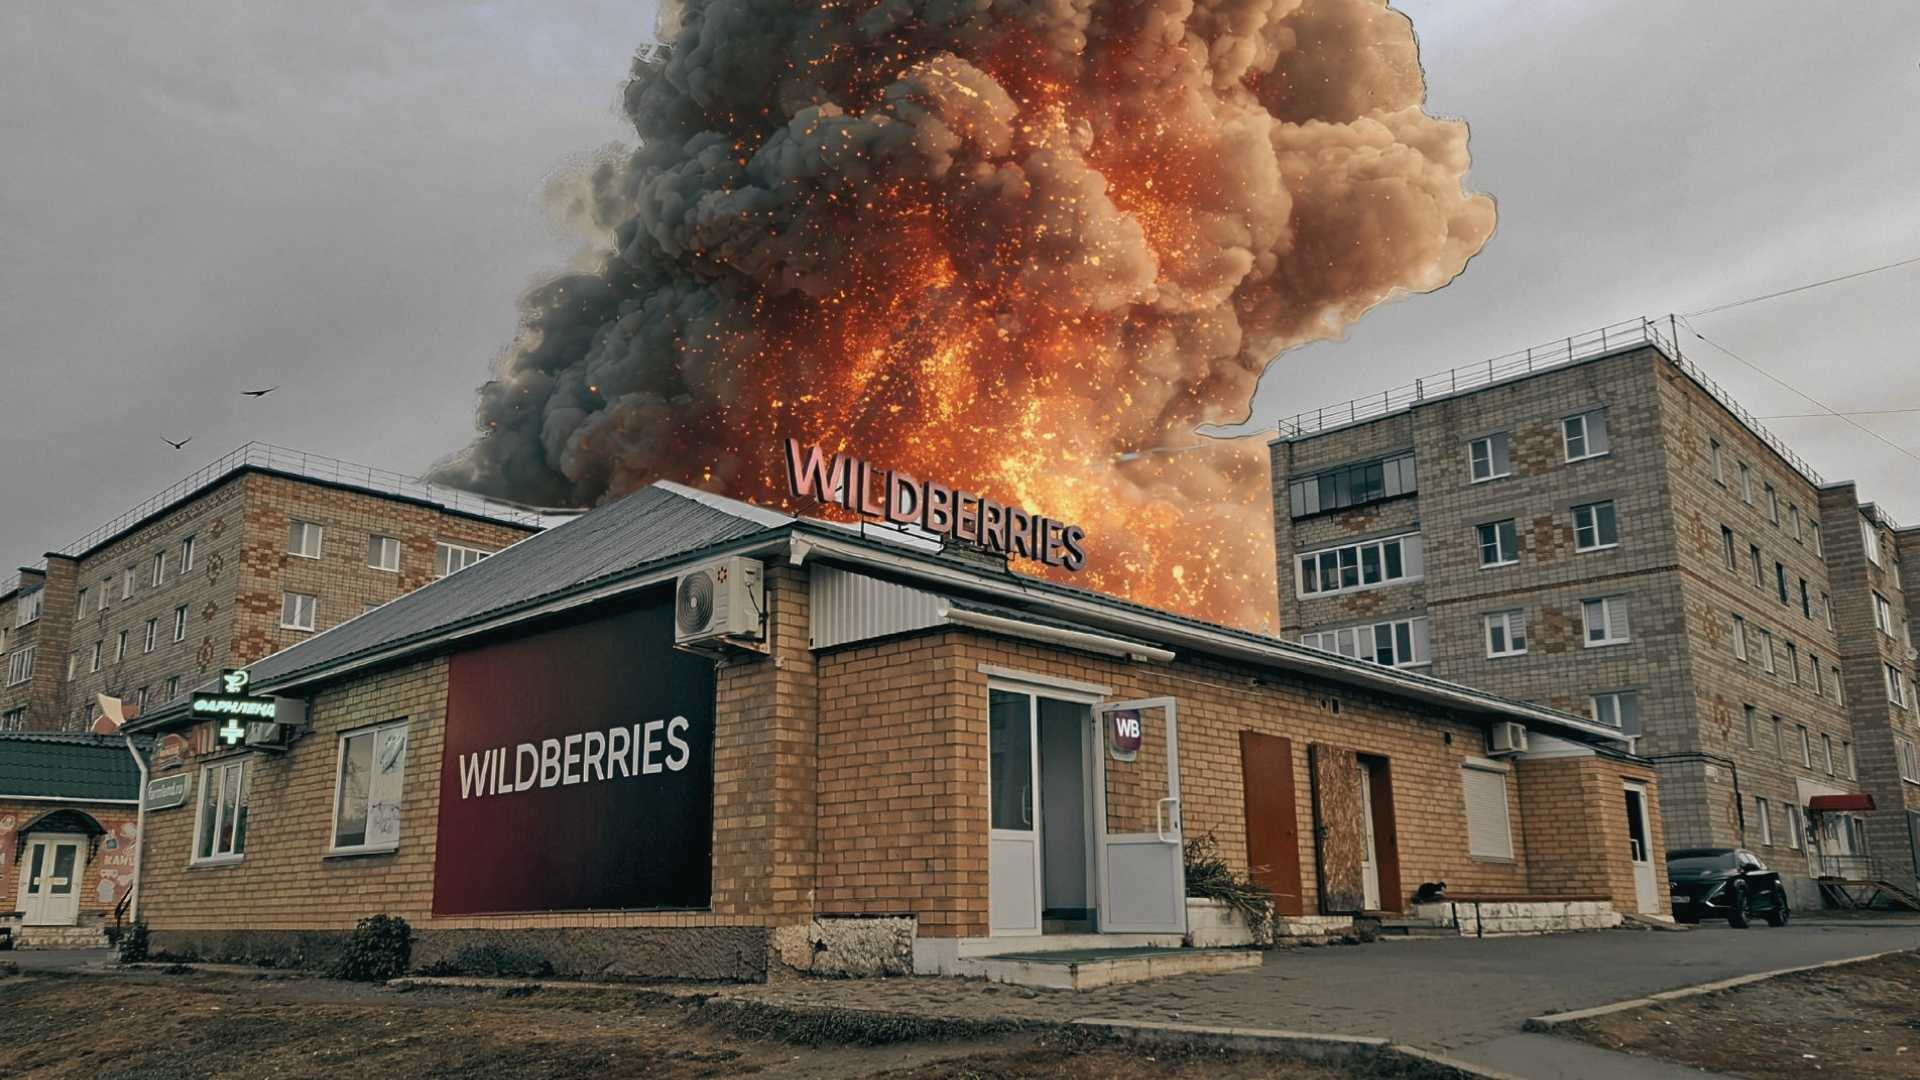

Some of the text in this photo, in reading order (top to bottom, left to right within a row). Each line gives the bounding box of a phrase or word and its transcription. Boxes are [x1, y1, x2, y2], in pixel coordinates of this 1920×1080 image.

[784, 438, 1086, 572] WILDBERRIES
[459, 715, 690, 799] WILDBERRIES
[1115, 717, 1140, 738] WB
